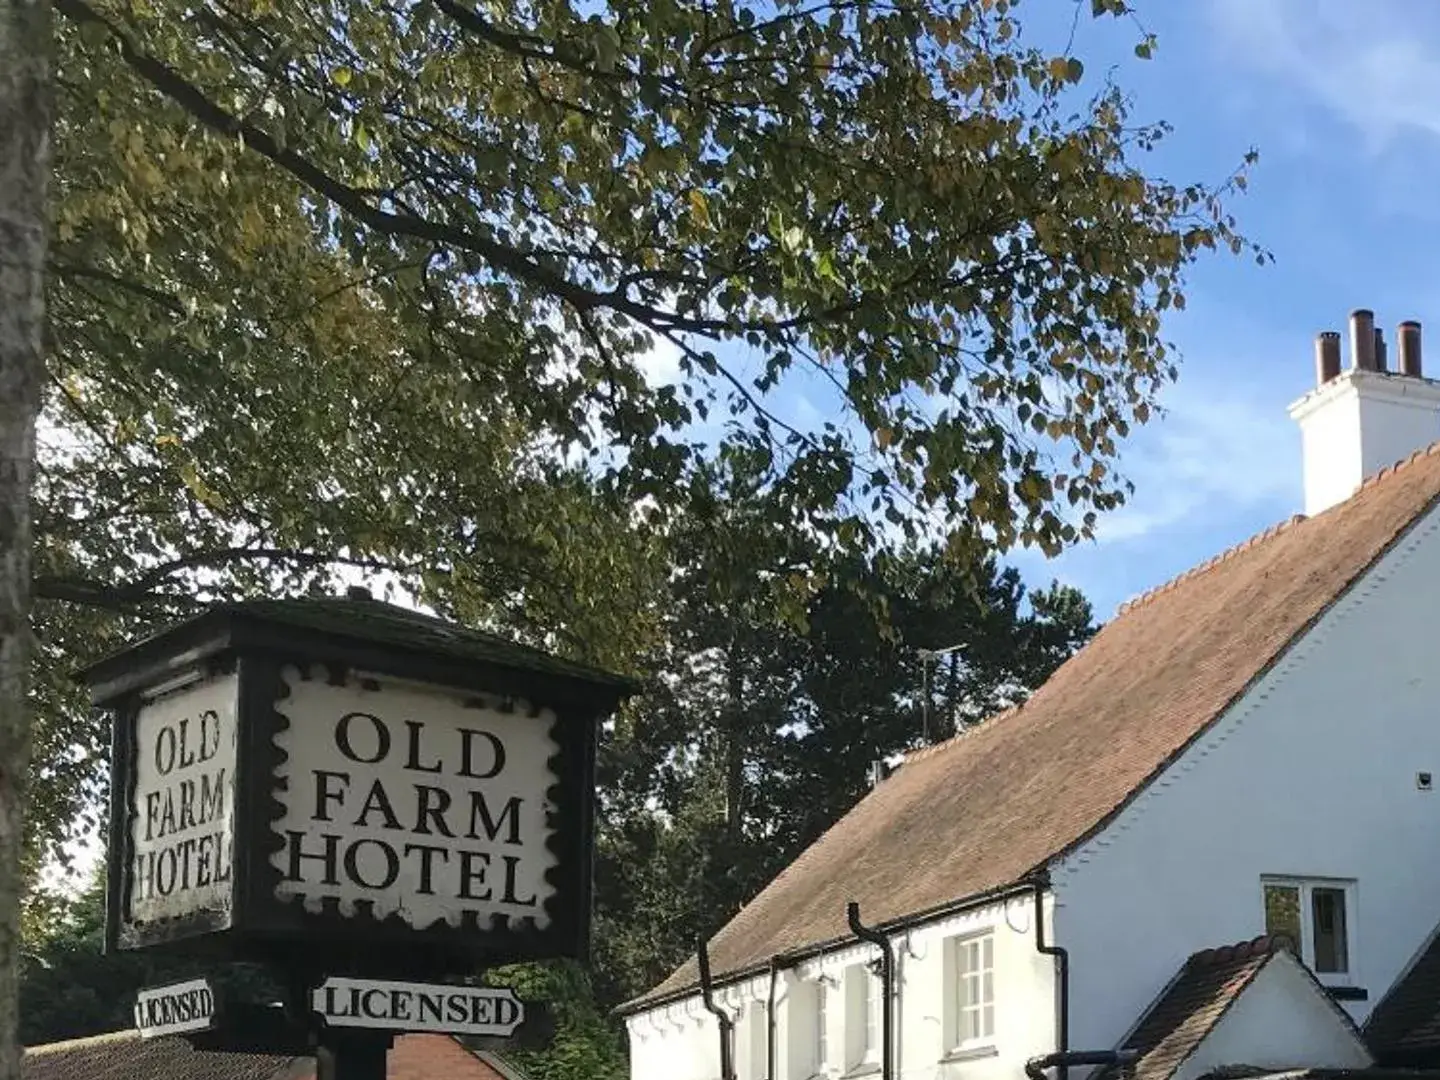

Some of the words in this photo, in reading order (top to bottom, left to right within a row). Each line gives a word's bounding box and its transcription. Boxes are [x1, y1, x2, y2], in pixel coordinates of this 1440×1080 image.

[155, 709, 220, 776] OLD
[334, 712, 506, 779] OLD
[143, 767, 226, 842] FARM
[311, 769, 524, 846] FARM
[136, 831, 231, 902] HOTEL
[285, 829, 537, 907] HOTEL
[137, 988, 213, 1029] LICENSED
[325, 986, 520, 1027] LICENSED
